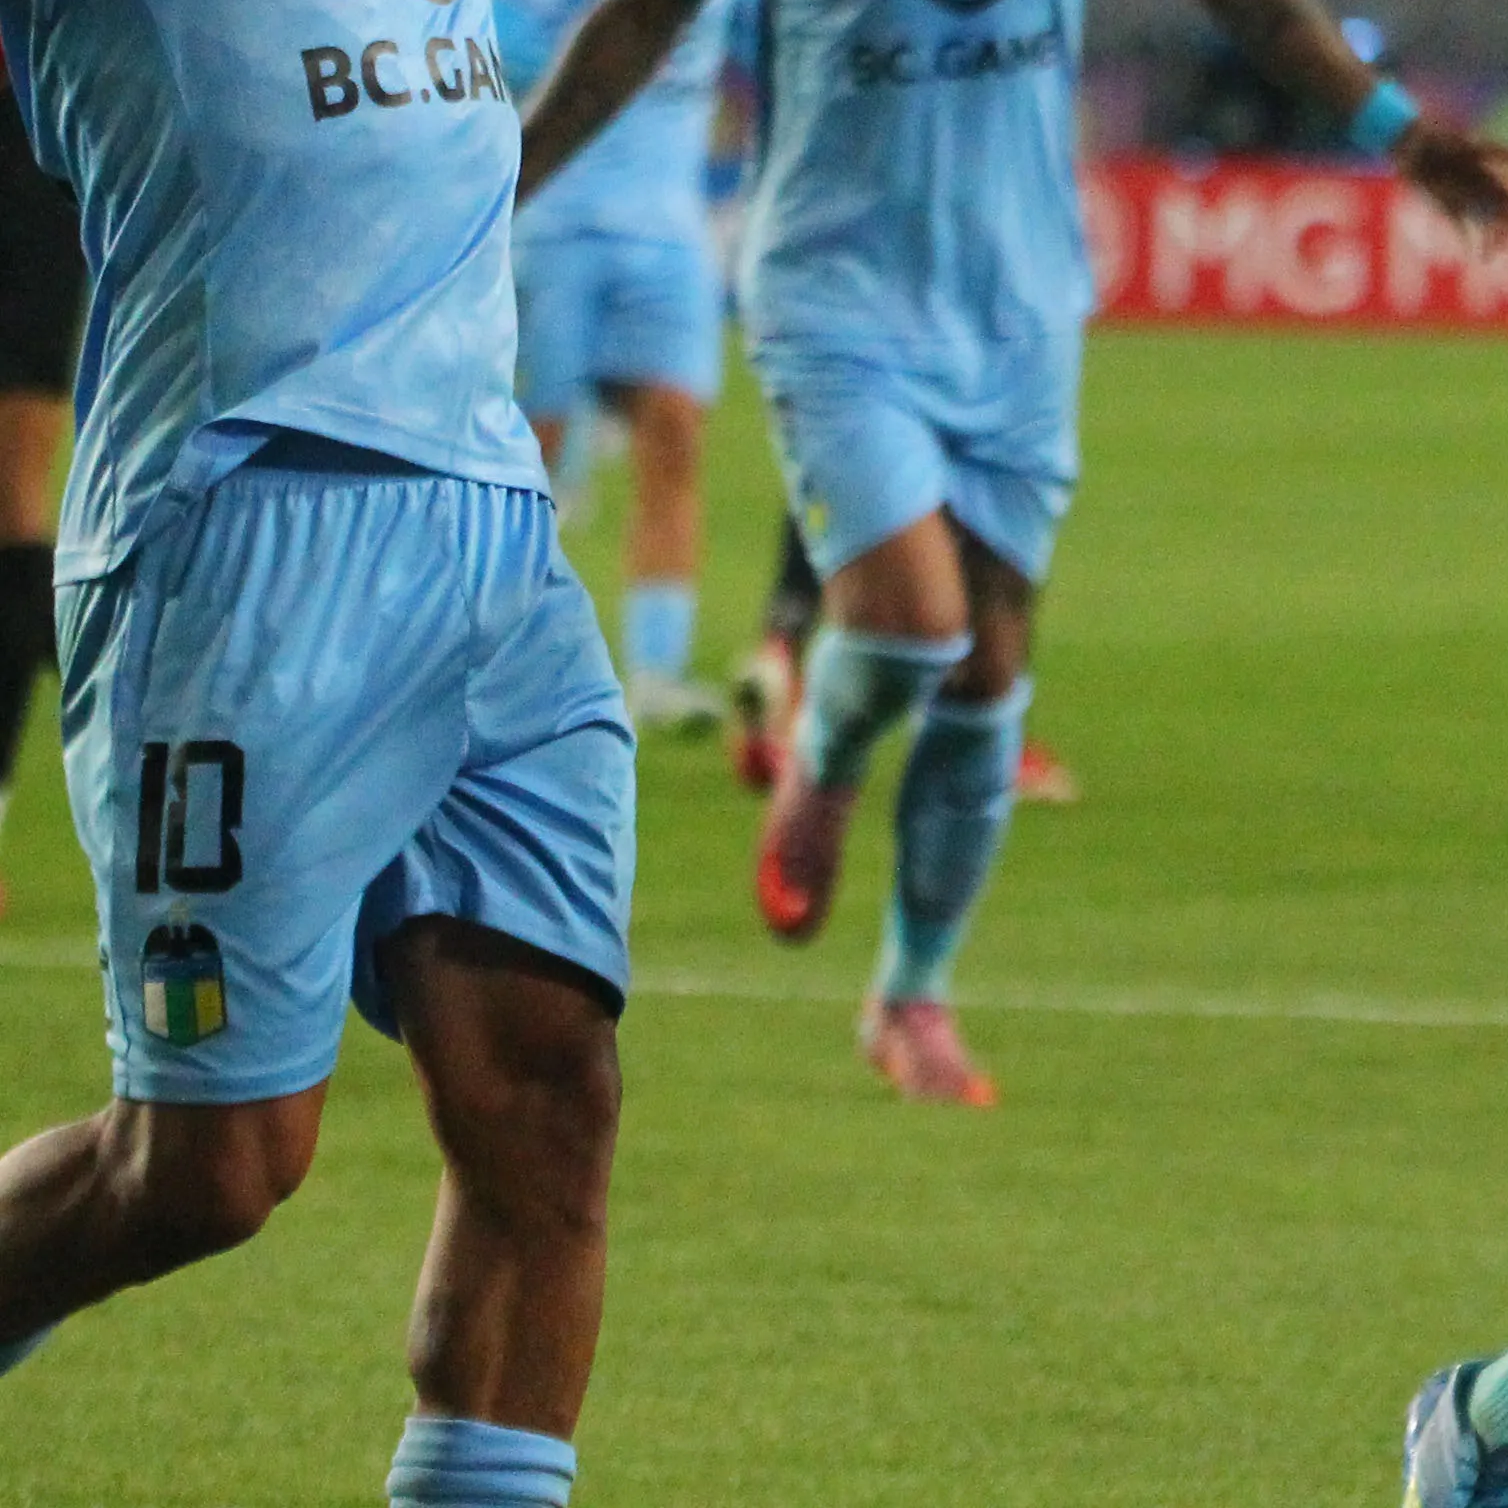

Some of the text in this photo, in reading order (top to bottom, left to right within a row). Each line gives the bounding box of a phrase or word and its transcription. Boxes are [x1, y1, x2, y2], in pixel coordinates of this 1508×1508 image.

[301, 37, 508, 122] BC.GA
[1151, 188, 1374, 317] MG
[136, 740, 244, 894] 10
